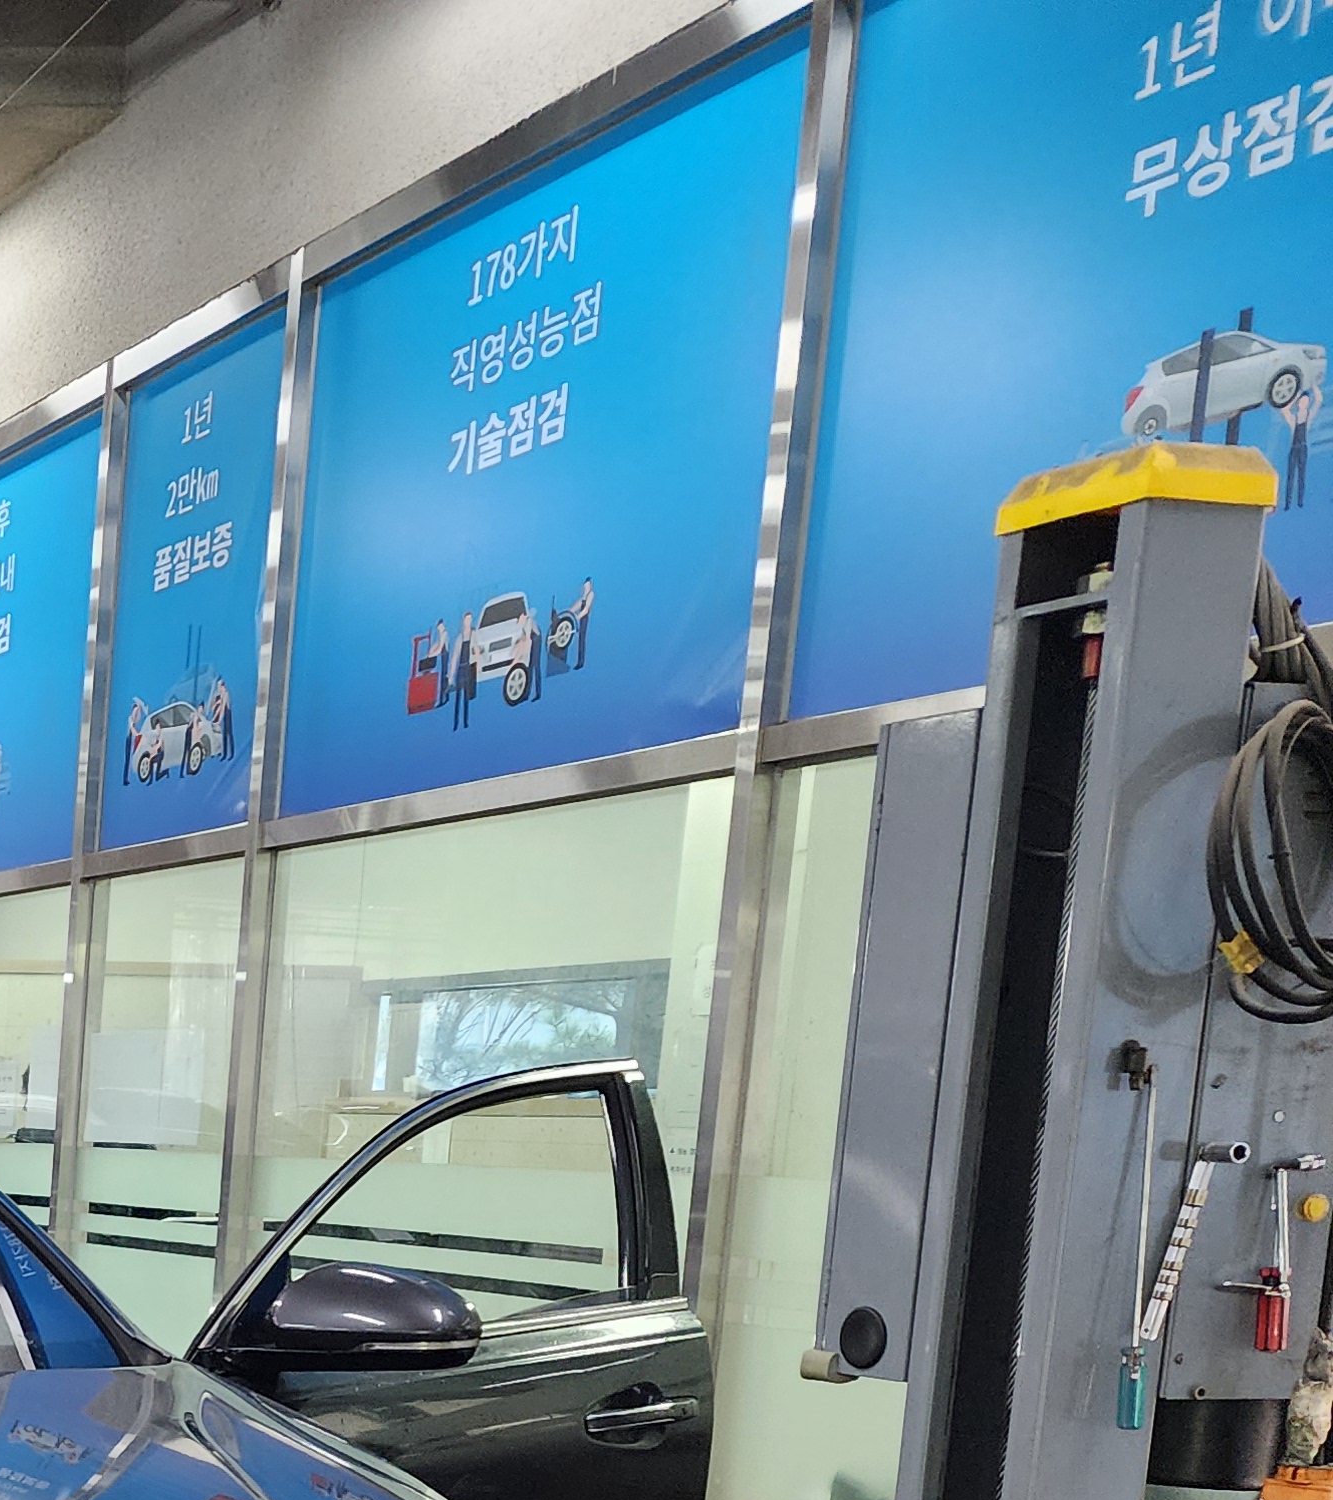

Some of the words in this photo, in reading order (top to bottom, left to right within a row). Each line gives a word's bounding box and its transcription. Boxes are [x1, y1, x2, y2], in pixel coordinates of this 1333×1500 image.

[1135, 0, 1221, 101] 1년
[467, 204, 579, 306] 178가지
[450, 280, 603, 392] 직영성능점
[181, 391, 213, 444] 1년
[447, 382, 569, 475] 기술점검
[165, 467, 220, 518] 2만km
[153, 521, 233, 592] 품질보증
